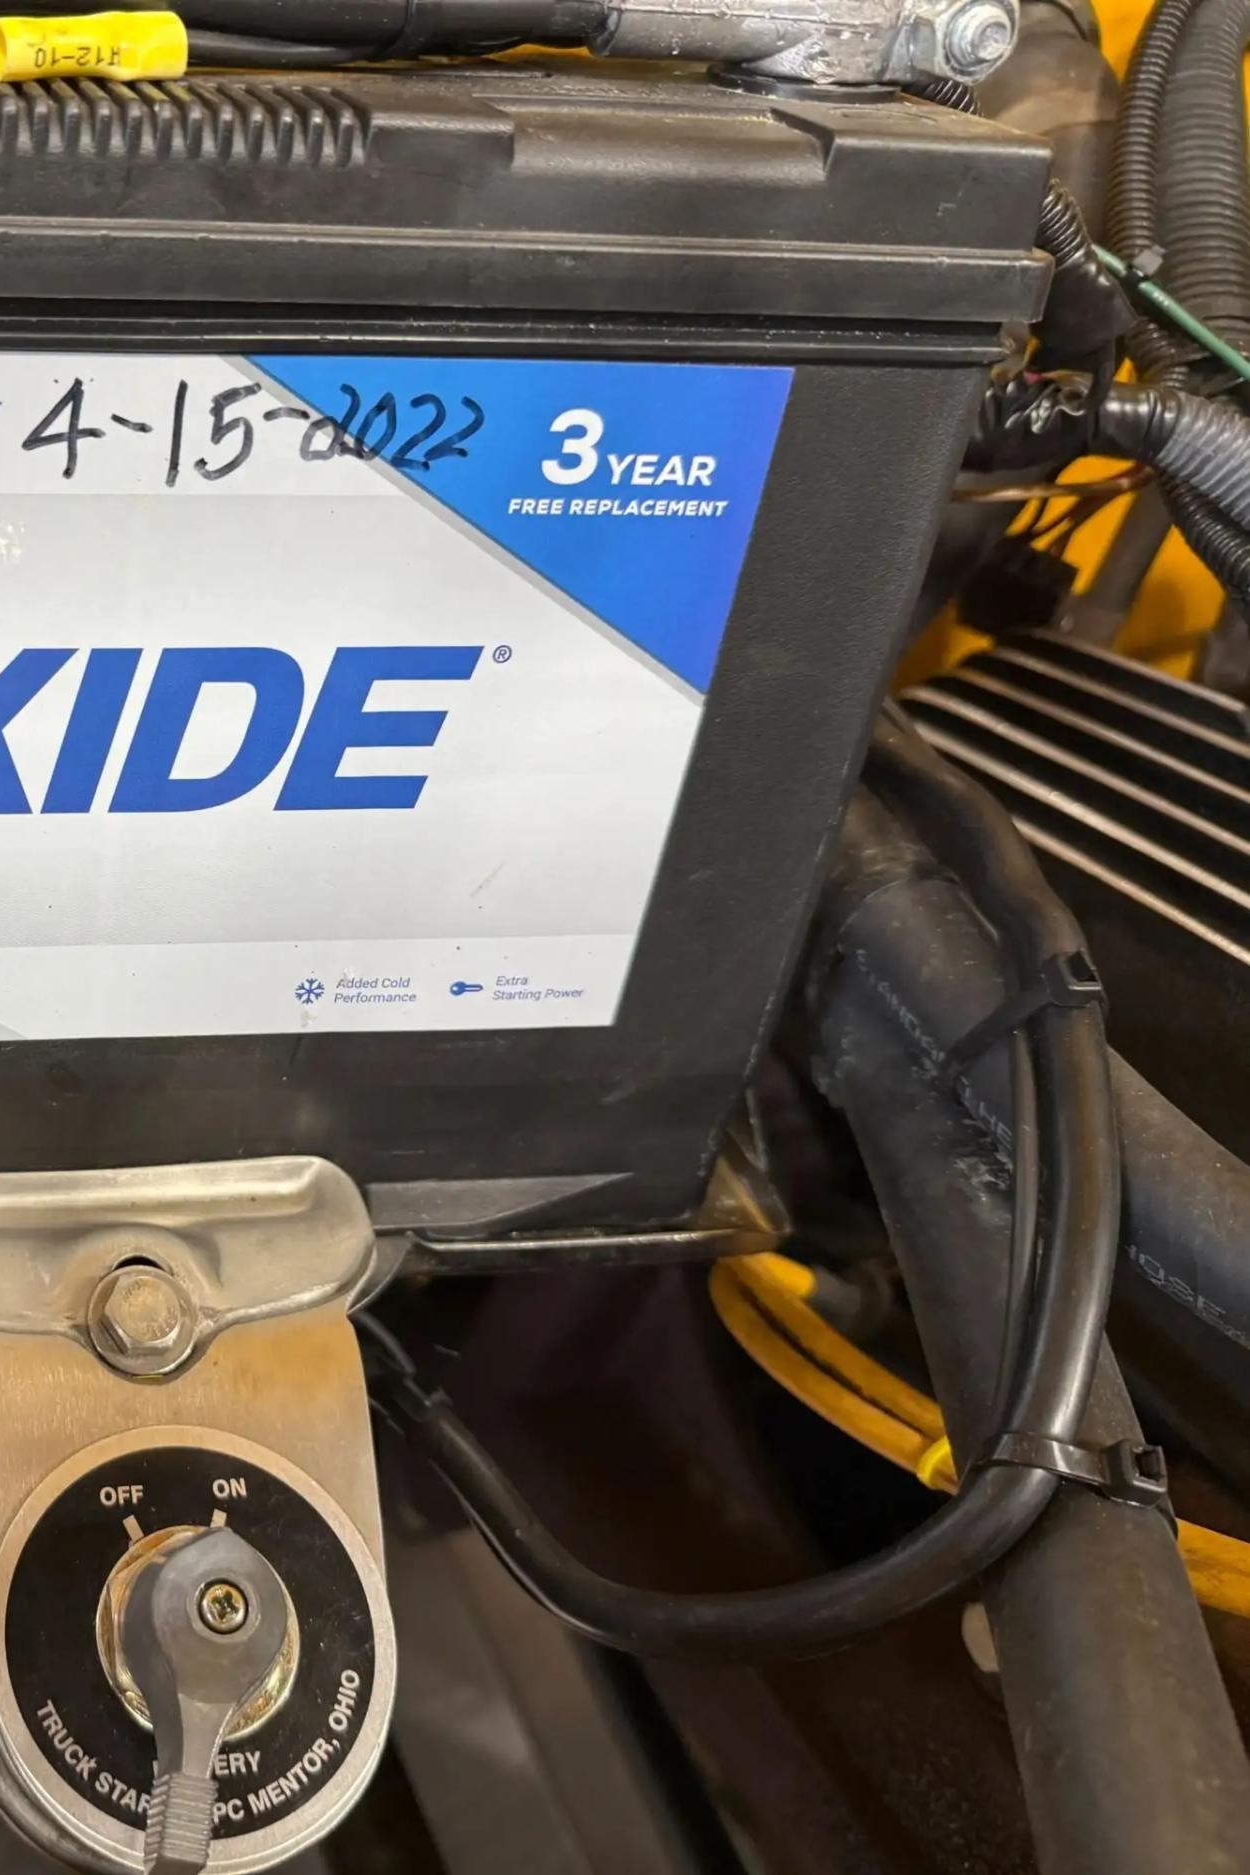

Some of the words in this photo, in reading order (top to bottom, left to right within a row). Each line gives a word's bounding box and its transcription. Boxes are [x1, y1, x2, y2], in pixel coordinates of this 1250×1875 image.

[541, 408, 604, 485] 3
[607, 454, 717, 487] YEAR
[508, 498, 564, 515] FREE
[568, 499, 729, 517] REPLACEMENT
[336, 976, 379, 990] Added
[381, 976, 411, 989] Cold
[496, 975, 529, 987] Extra
[334, 991, 417, 1004] Performance
[492, 988, 542, 1002] Starting
[544, 987, 584, 1000] Power
[99, 1484, 144, 1506] OFF
[212, 1477, 247, 1500] ON
[37, 1698, 97, 1781] TRUCK
[247, 1737, 341, 1815] MENTOR,
[328, 1669, 361, 1732] OHIO
